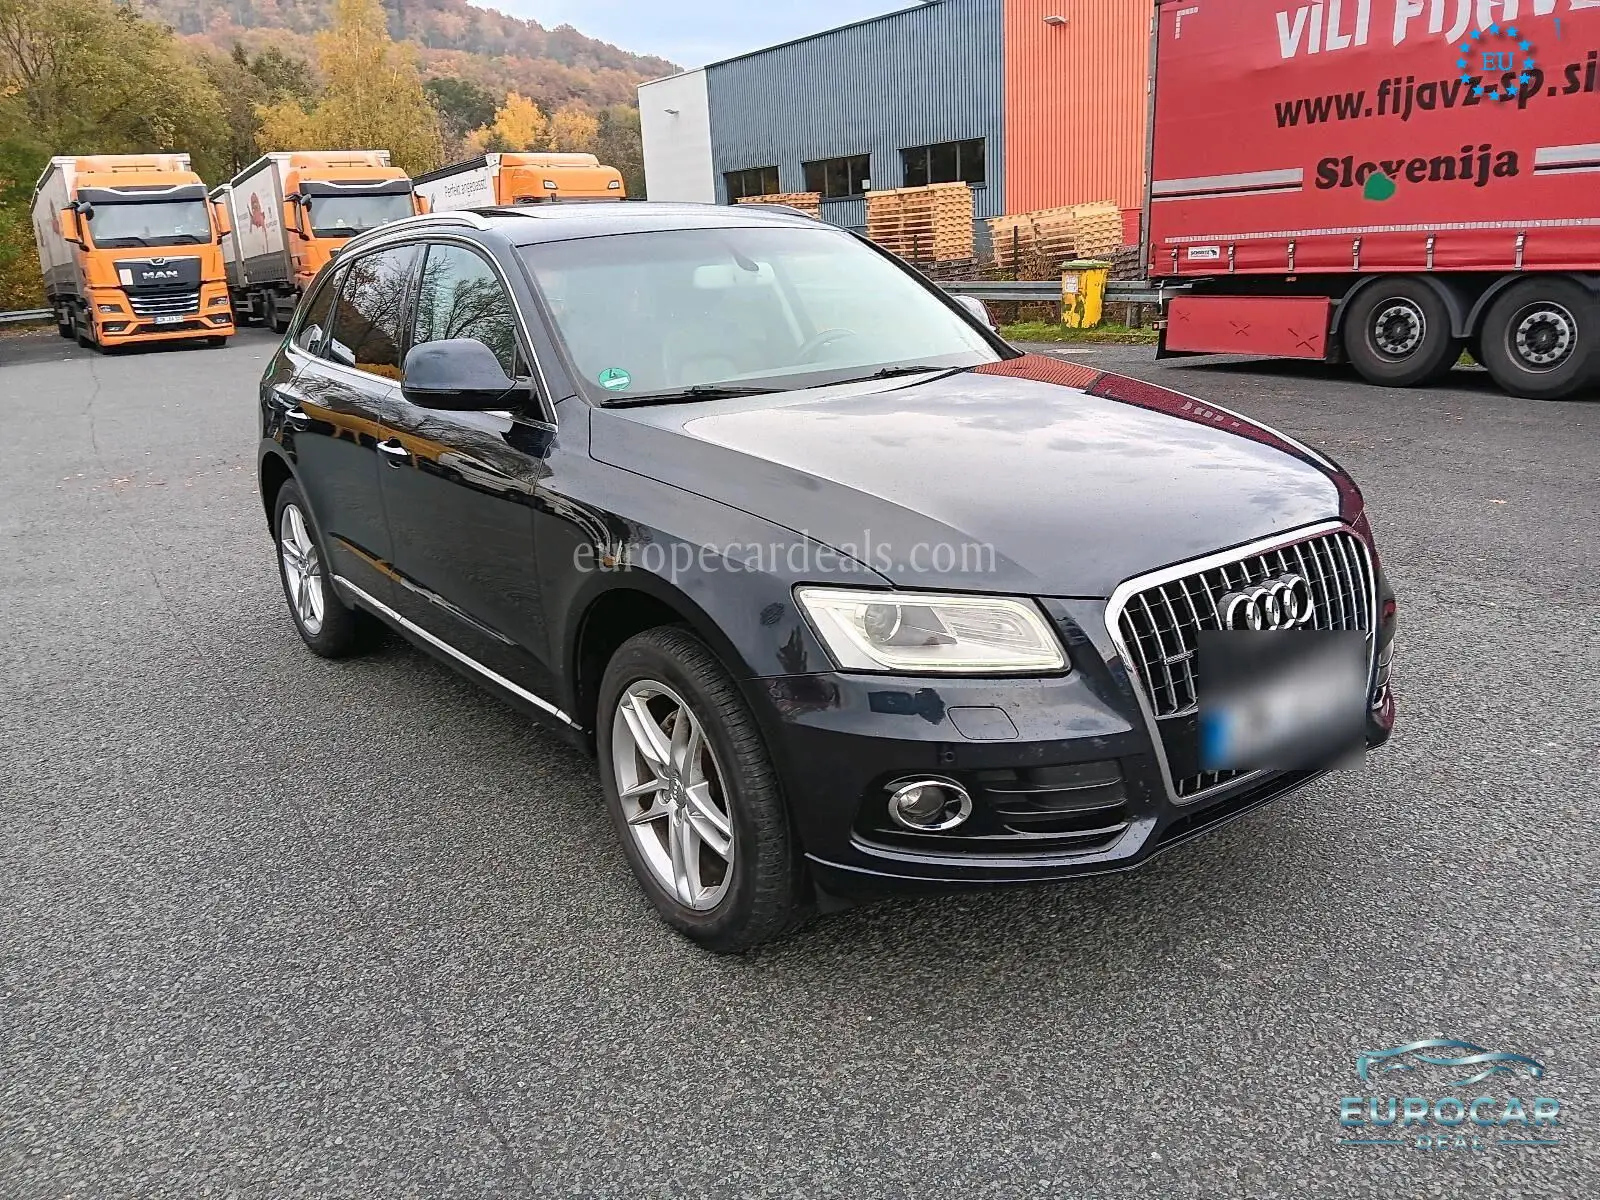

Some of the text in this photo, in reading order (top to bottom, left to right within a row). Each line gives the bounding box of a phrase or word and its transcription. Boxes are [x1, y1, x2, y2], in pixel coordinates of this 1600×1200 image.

[1274, 50, 1598, 128] www.fijavz-sp.si
[1315, 143, 1520, 190] Slovenija
[142, 270, 179, 280] MAN
